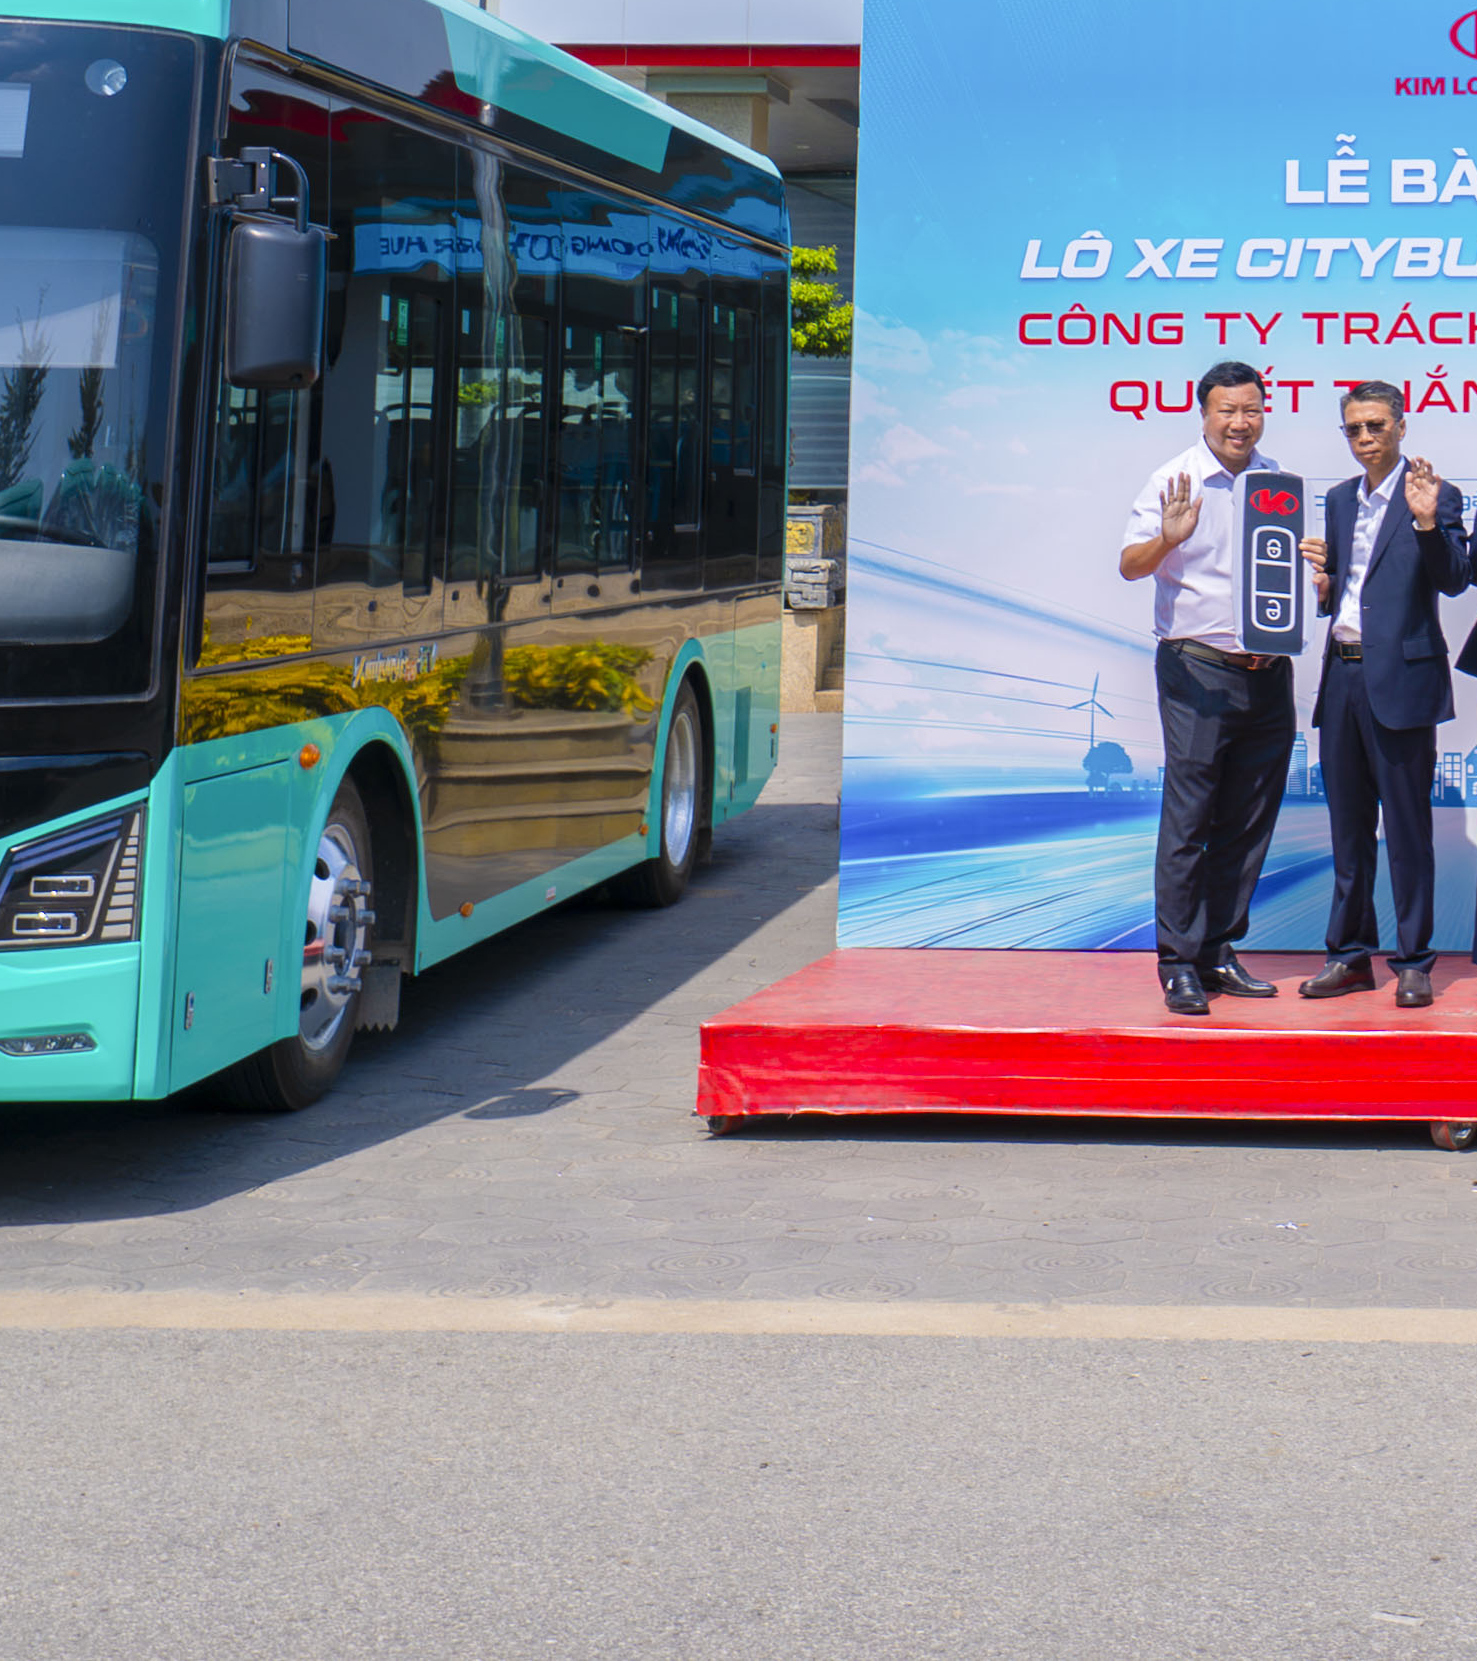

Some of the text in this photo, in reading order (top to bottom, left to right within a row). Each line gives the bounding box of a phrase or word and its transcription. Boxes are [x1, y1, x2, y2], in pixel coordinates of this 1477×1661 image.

[1395, 77, 1446, 95] KIM
[1285, 134, 1370, 204] LỄ
[1020, 230, 1113, 278] LÔ
[1125, 238, 1224, 278] XE
[1018, 303, 1184, 345] CÔNG
[1204, 312, 1283, 345] TY
[1110, 366, 1314, 420] QUT
